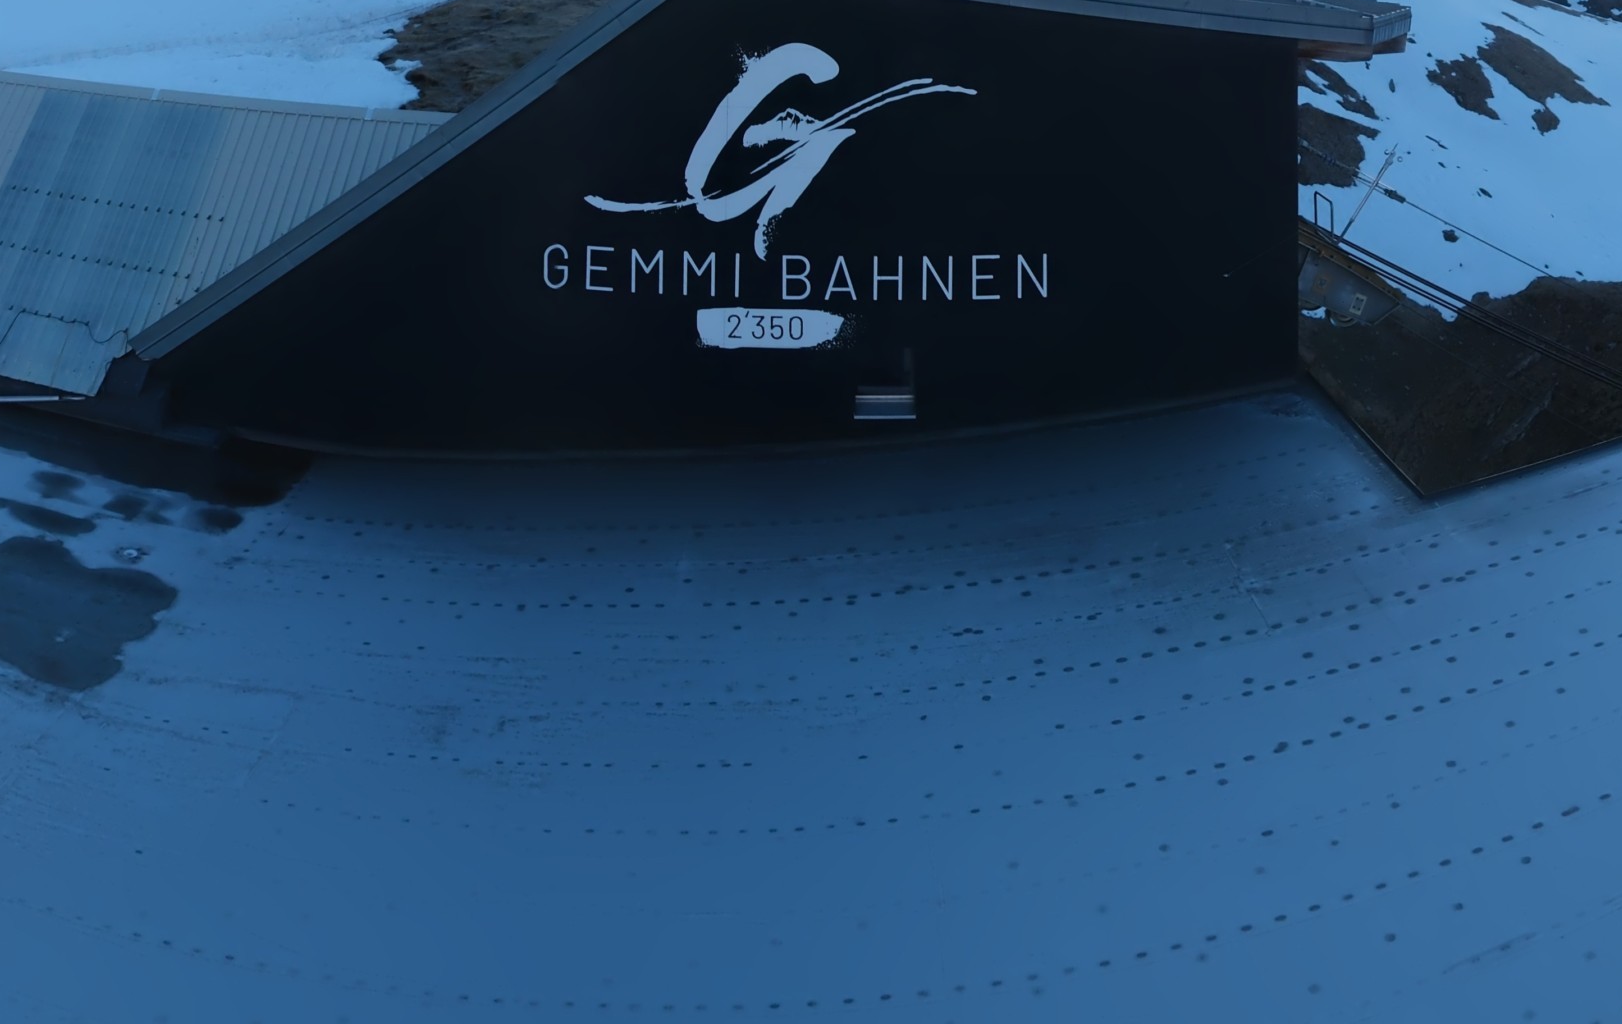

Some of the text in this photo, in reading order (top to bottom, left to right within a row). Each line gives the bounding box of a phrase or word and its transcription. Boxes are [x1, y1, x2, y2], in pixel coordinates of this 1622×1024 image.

[544, 244, 1048, 300] GEMMI BAHNEN
[727, 310, 804, 340] 2'350
